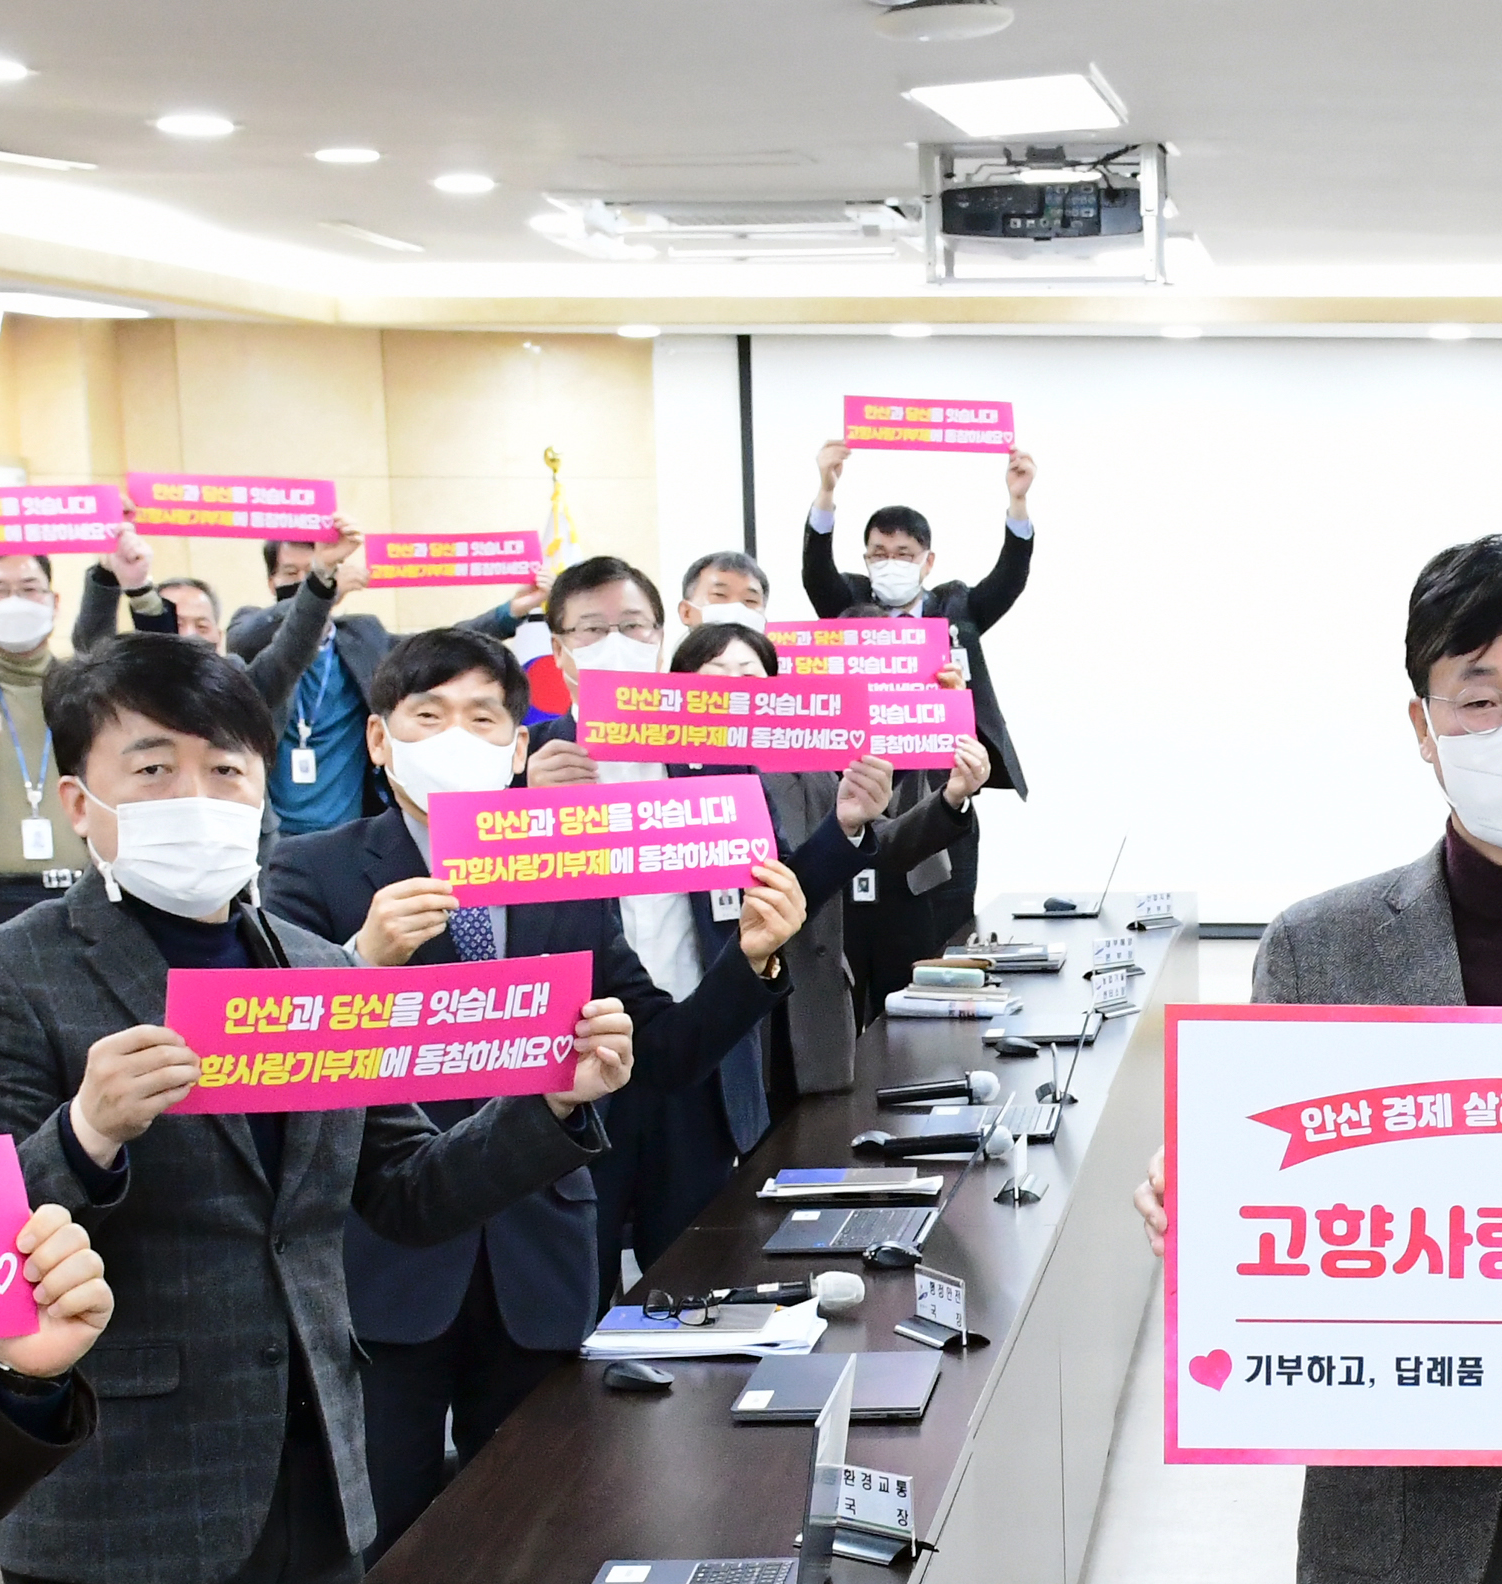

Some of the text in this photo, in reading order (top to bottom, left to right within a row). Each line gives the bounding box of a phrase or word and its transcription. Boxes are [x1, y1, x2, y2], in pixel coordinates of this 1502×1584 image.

[796, 656, 844, 674] 당신을
[848, 656, 918, 674] 잇습니다!
[616, 687, 841, 716] 안산과 당신을 잇습니다!
[870, 704, 945, 724] 잇습니다!
[584, 721, 848, 749] 고향사랑기부제에 동참하세요
[870, 735, 955, 754] 동참하세요
[476, 795, 737, 840] 안산과 당신을 잇습니다!
[442, 839, 751, 886] 고향사랑기부제에 동참하세요
[225, 982, 550, 1034] 안산과 당신을 잇습니다!
[198, 1036, 551, 1087] 향사랑기부제에 동참하세요
[1300, 1099, 1372, 1141] 안산
[1383, 1093, 1452, 1131] 경제
[1245, 1355, 1375, 1388] 기부하고,
[1396, 1356, 1484, 1386] 답례품
[843, 1468, 908, 1498] 환경교통
